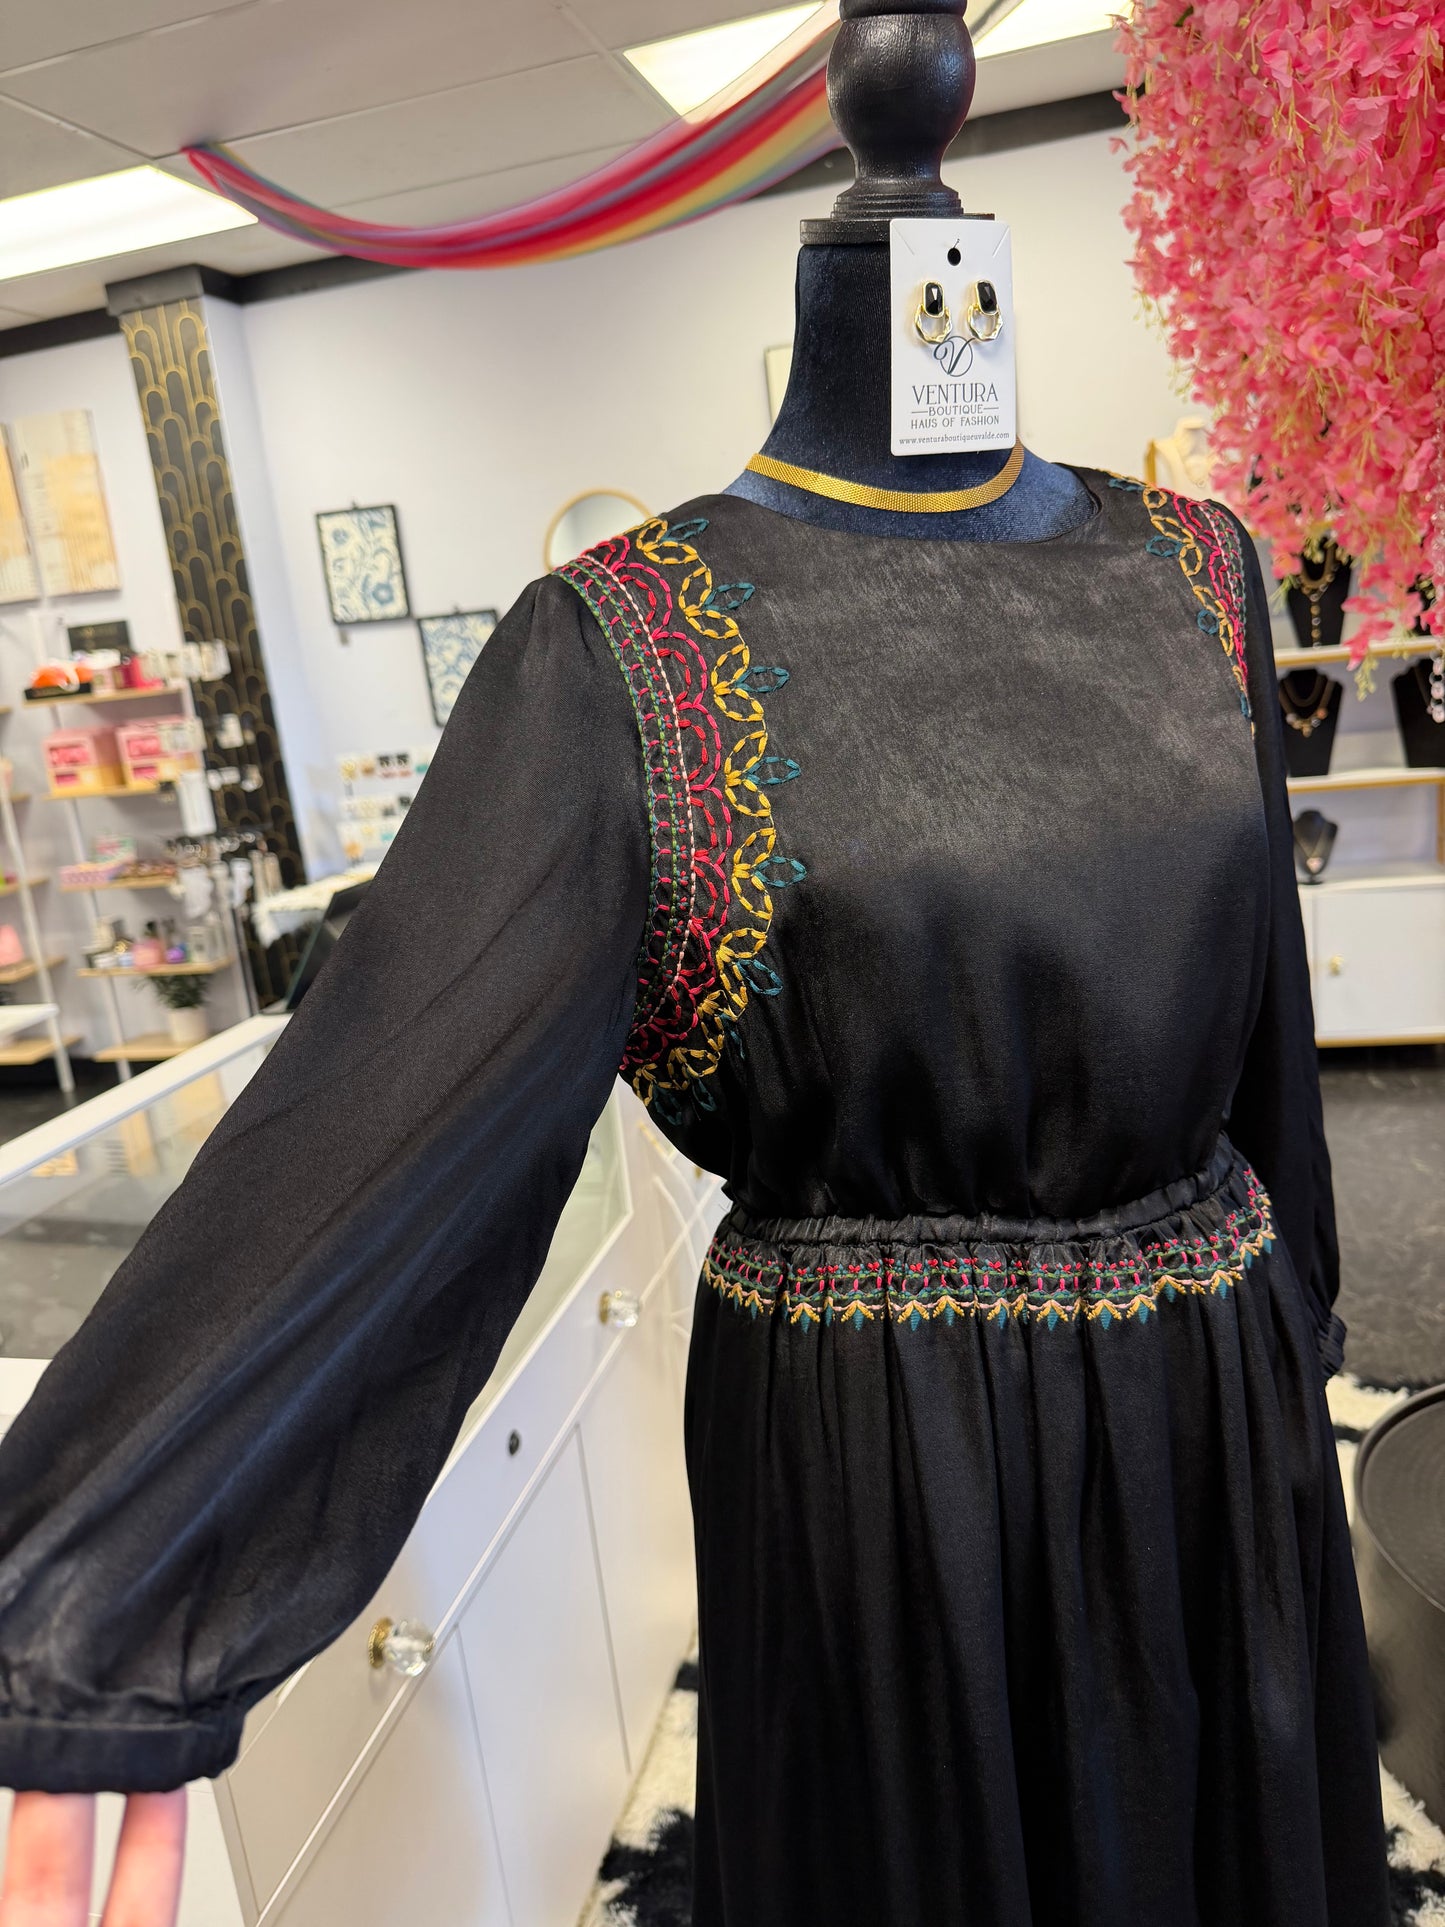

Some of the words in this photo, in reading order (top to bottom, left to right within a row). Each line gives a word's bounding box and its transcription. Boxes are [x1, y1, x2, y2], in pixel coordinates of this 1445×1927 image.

[912, 382, 998, 405] VENTURA
[929, 404, 983, 416] BOUTIQUE
[911, 418, 938, 429] HAUS
[942, 417, 956, 427] OF
[961, 415, 999, 426] FASHION
[899, 432, 1009, 444] www.venturaboutiqueuvalde.com
